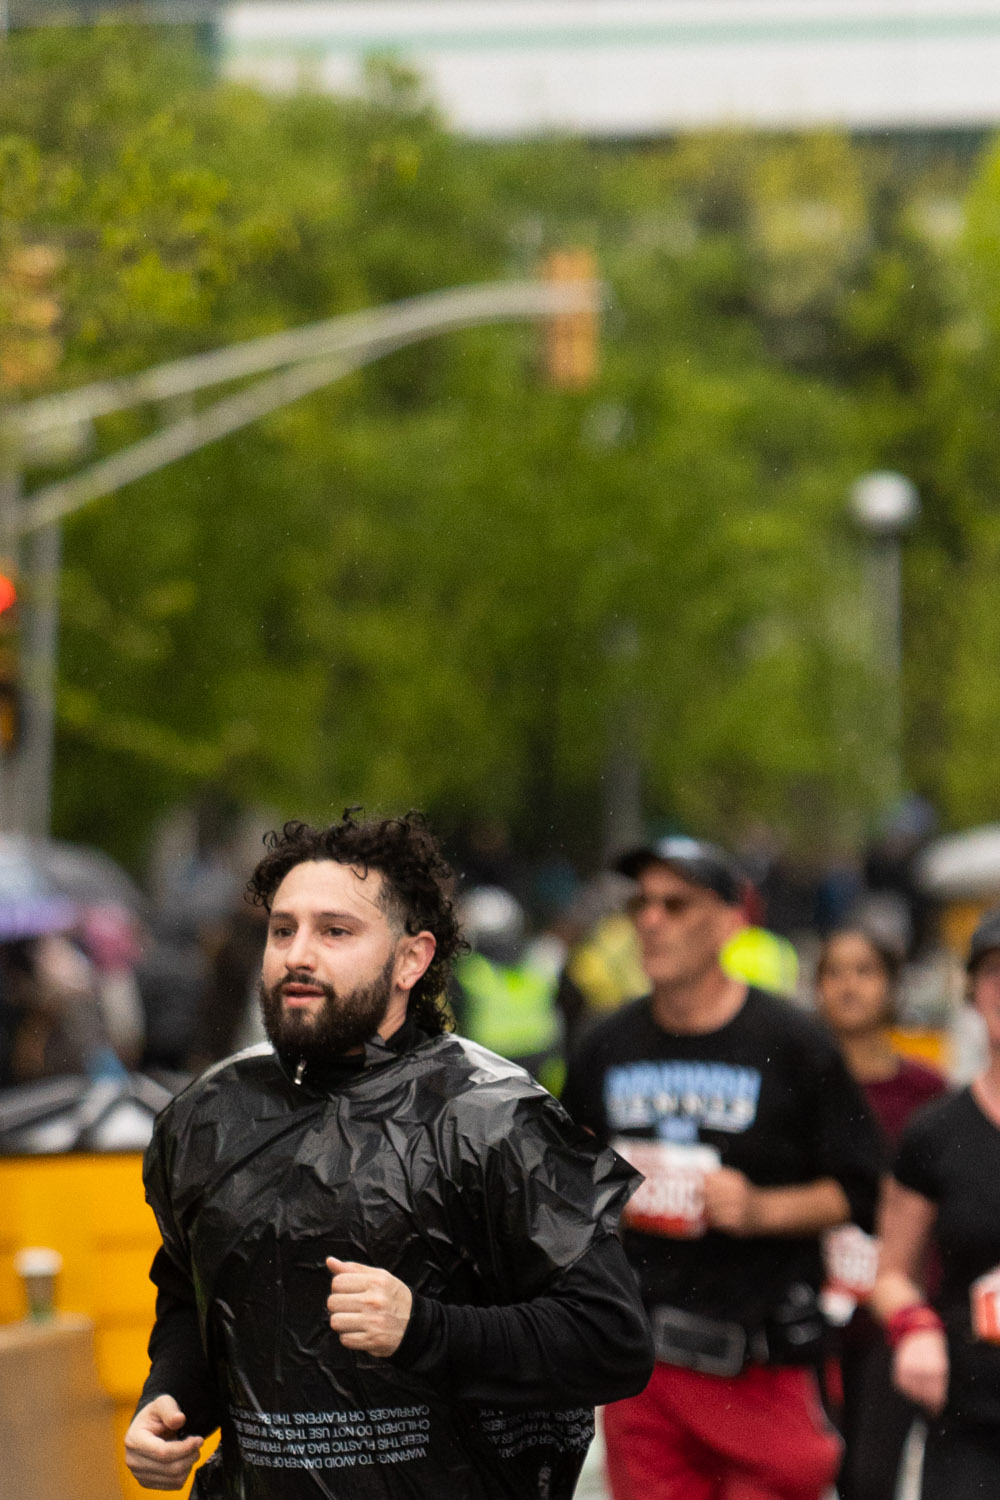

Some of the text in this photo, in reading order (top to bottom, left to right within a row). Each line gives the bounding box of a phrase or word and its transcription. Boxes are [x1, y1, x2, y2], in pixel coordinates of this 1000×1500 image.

[273, 1414, 291, 1424] THIS
[349, 1411, 365, 1422] OR
[285, 1429, 307, 1440] THIS
[309, 1428, 330, 1439] USE
[331, 1427, 354, 1438] NOT
[357, 1426, 373, 1436] DO
[377, 1438, 400, 1450] THIS
[401, 1434, 429, 1445] KEEP
[307, 1443, 330, 1454] BAG
[332, 1440, 375, 1453] PLASTIC
[359, 1454, 374, 1465] TO
[376, 1447, 426, 1463] WARNING:
[272, 1457, 283, 1467] OF
[284, 1457, 322, 1469] DANGER
[325, 1456, 356, 1468] AVOID
